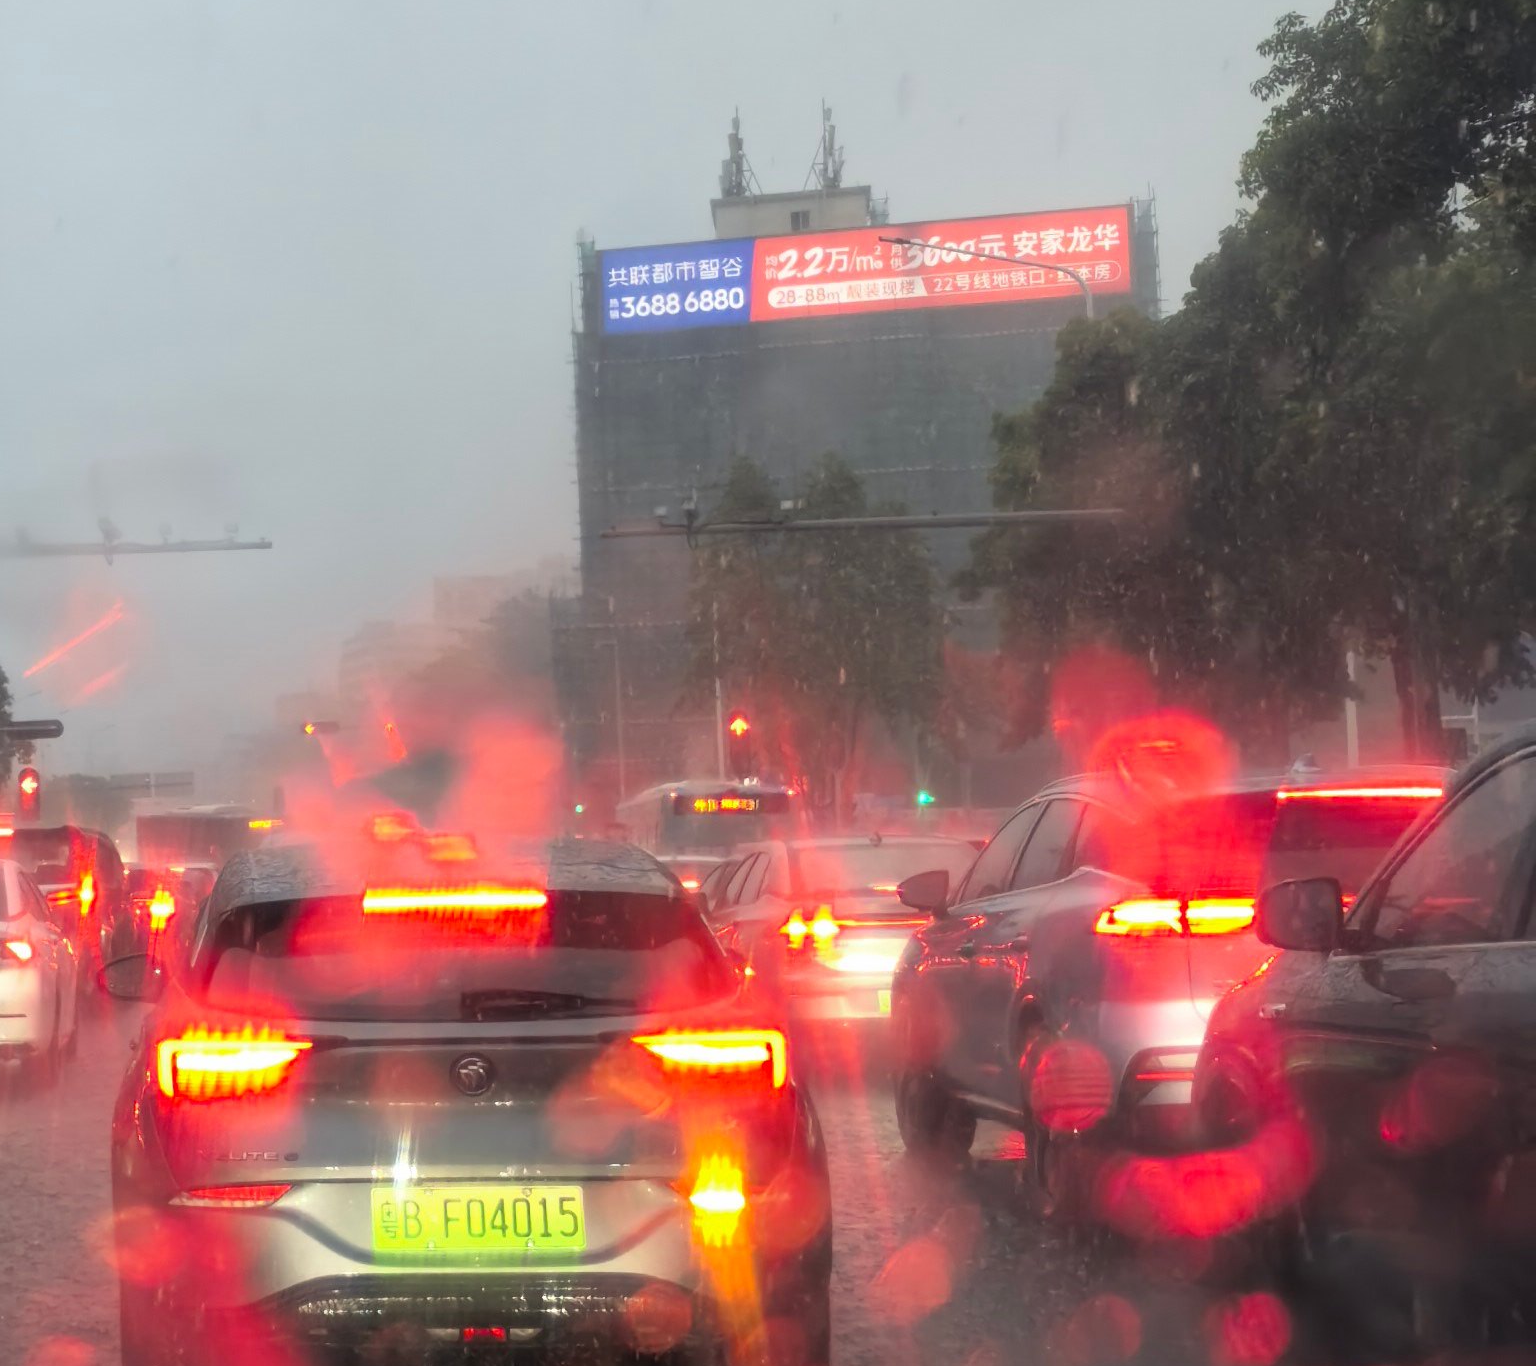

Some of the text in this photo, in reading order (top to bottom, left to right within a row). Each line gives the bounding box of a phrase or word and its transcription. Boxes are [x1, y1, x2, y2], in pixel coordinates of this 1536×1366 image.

[1013, 224, 1120, 257] 安家龙华
[607, 256, 743, 288] 共联都市智谷
[620, 293, 681, 319] 3688
[684, 287, 745, 313] 6880
